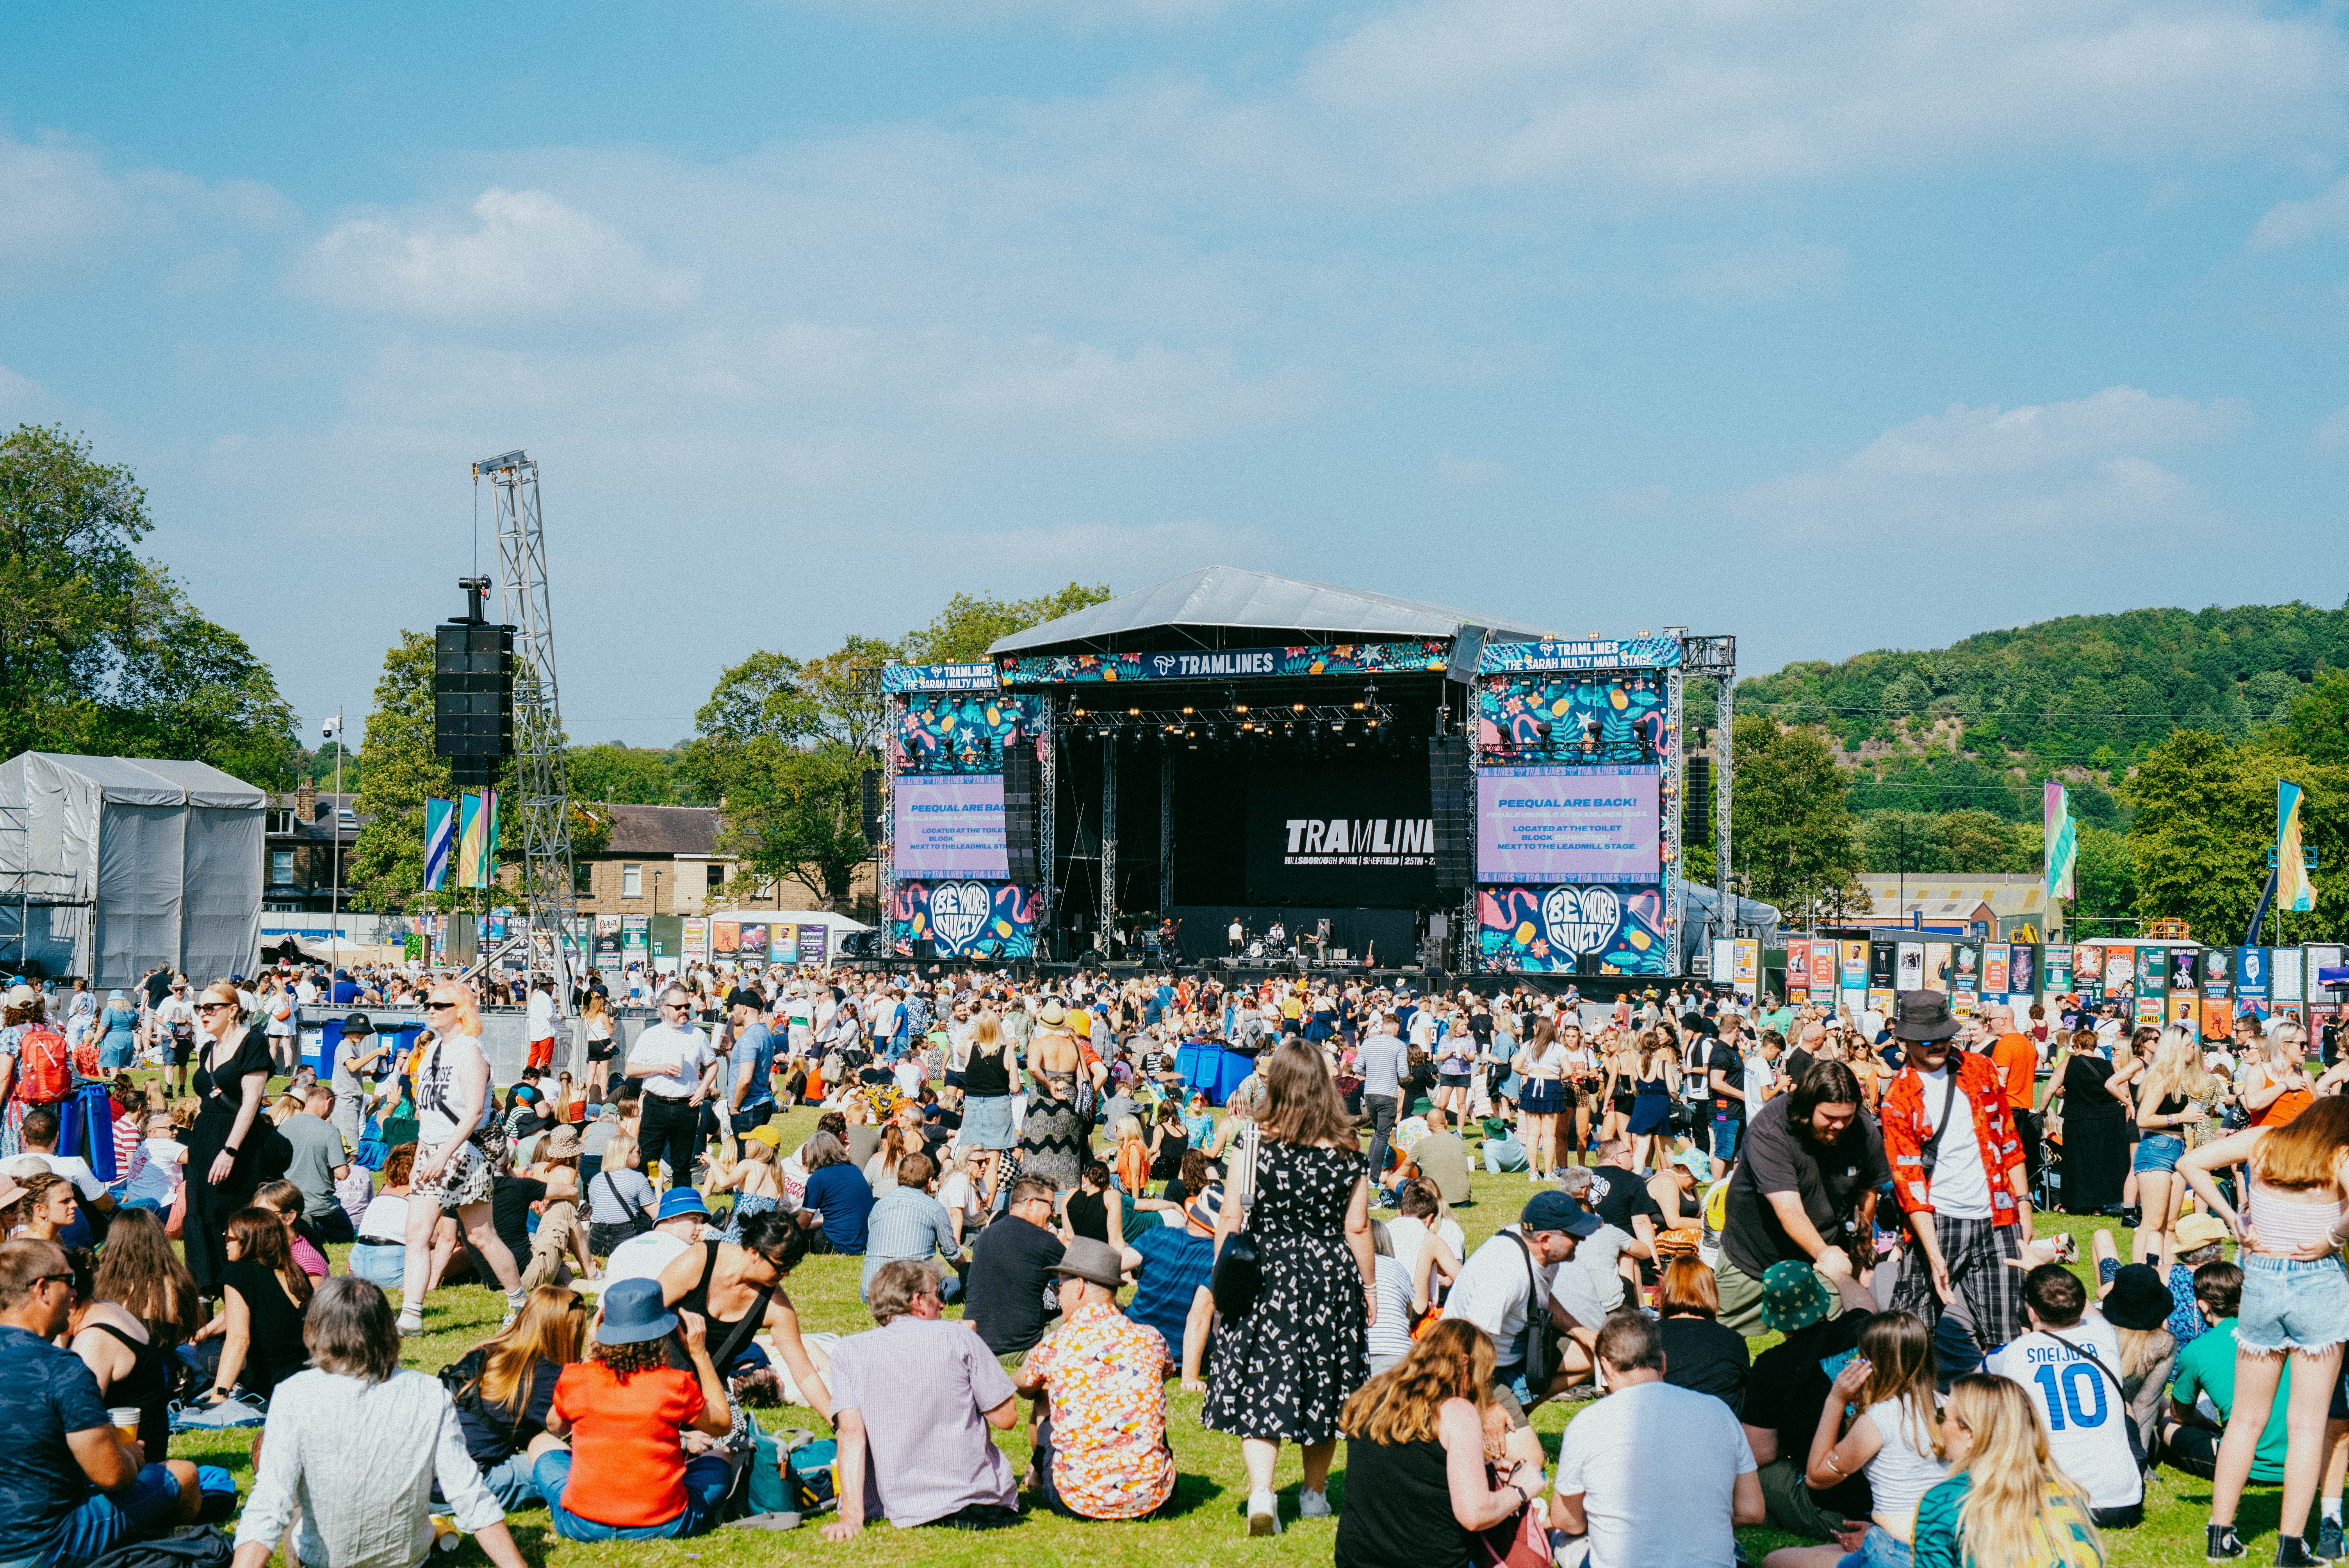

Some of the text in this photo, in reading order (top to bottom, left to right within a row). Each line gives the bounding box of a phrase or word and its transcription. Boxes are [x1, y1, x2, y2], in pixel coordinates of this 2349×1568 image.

[1556, 641, 1619, 656] TRAMLINES
[1179, 653, 1273, 675] TRAMLINES
[1504, 654, 1652, 671] THE SARAH NULTY MAIN STAGE
[944, 665, 993, 678] TRAMLINES
[904, 680, 918, 690] THE
[920, 678, 946, 689] SARAH
[947, 677, 971, 689] NULTY
[972, 678, 992, 688] MAIN
[1526, 766, 1567, 776] TRAMLINES
[1577, 766, 1619, 775] TRAMLINES
[932, 776, 964, 784] TRAMLINES
[1499, 798, 1637, 807] PEEQUAL ARE BACK!
[1285, 856, 1338, 865] HILLSBOROUGH
[1338, 856, 1358, 865] PARK
[1363, 856, 1399, 865] SHEFFIELD
[1404, 857, 1423, 865] 25TH
[932, 870, 964, 878] TRAMLINES
[973, 870, 1005, 878] TRAMLINES
[1526, 873, 1567, 883] TRAMLINES
[1577, 873, 1619, 882] TRAMLINES
[935, 885, 986, 915] BE MORE
[1549, 890, 1615, 925] BE MORE
[508, 919, 526, 927] PINS
[599, 919, 618, 929] CLAUSE
[936, 914, 982, 944] NULTY
[1551, 923, 1611, 954] NULTY
[1813, 948, 1832, 956] GIRLS
[1987, 952, 2006, 961] GIRLS
[2095, 989, 2101, 999] X
[1790, 995, 1807, 1004] PARTY
[2034, 1363, 2107, 1431] 10
